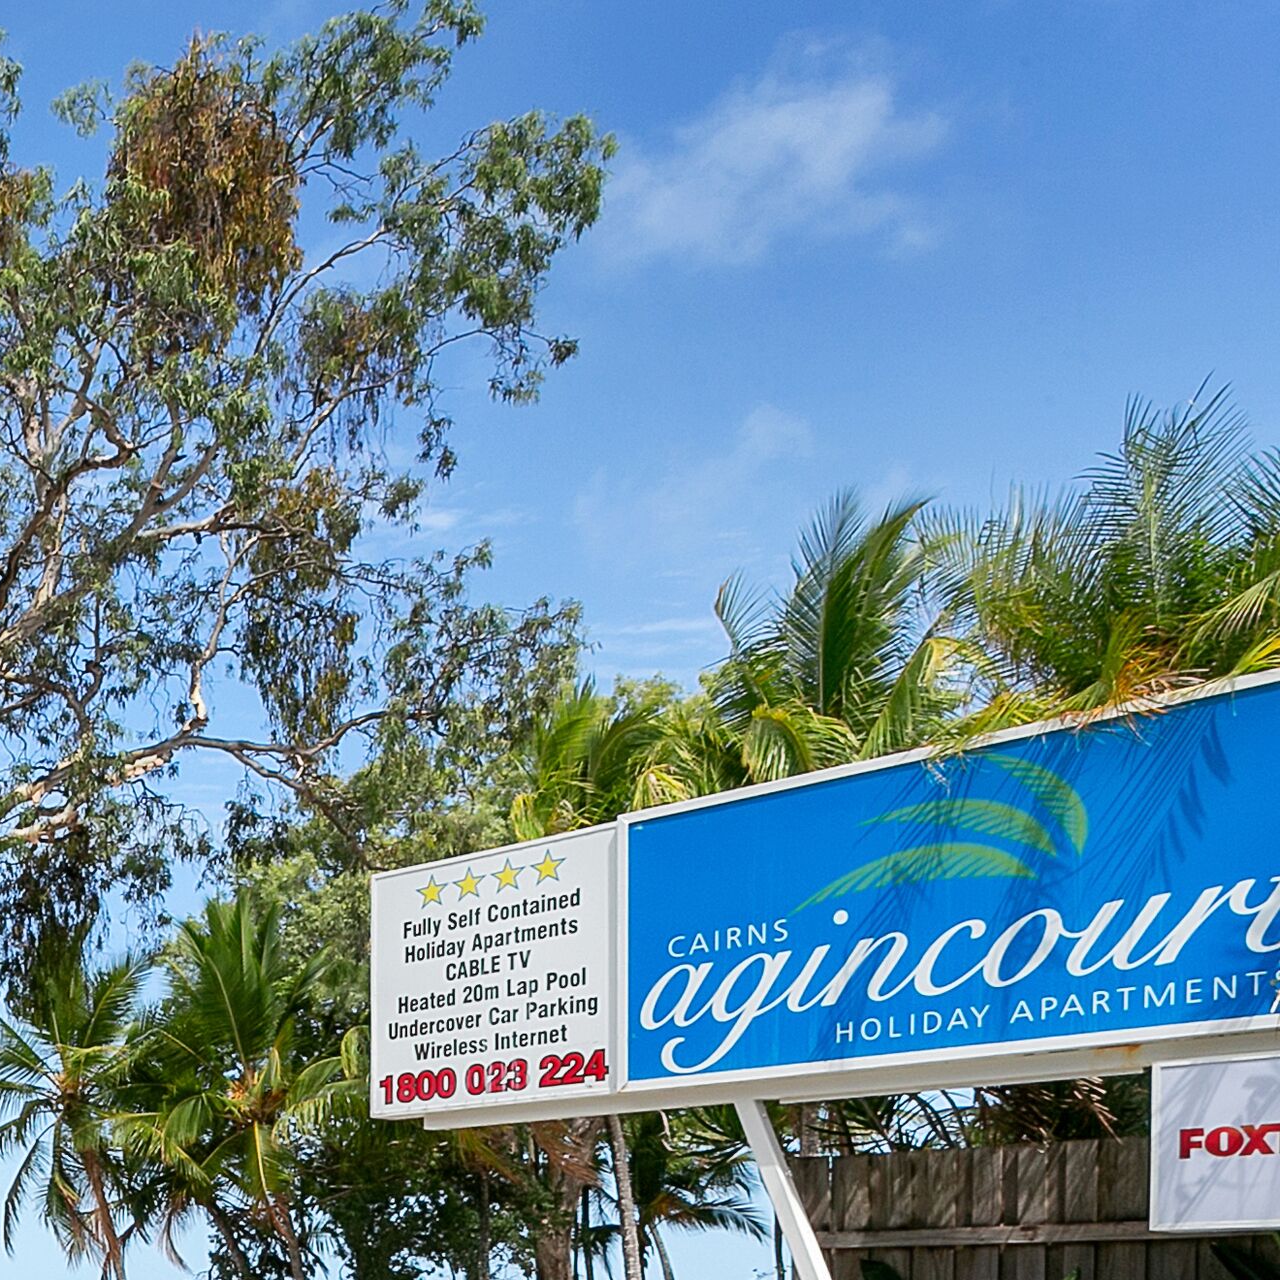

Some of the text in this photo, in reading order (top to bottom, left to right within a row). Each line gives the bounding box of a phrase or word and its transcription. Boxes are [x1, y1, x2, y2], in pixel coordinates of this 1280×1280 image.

[403, 888, 581, 939] Fully Self Contained
[405, 919, 578, 964] Holiday Apartments
[668, 918, 789, 958] CAIRNS
[446, 950, 532, 981] CABLE TV
[398, 968, 587, 1014] Heated 20m Lap Pool
[835, 970, 1280, 1043] HOLIDAY APARTMENT
[388, 995, 598, 1040] Undercover Car Parking
[414, 1025, 568, 1061] Wireless Internet
[379, 1049, 609, 1105] 1800 023 224
